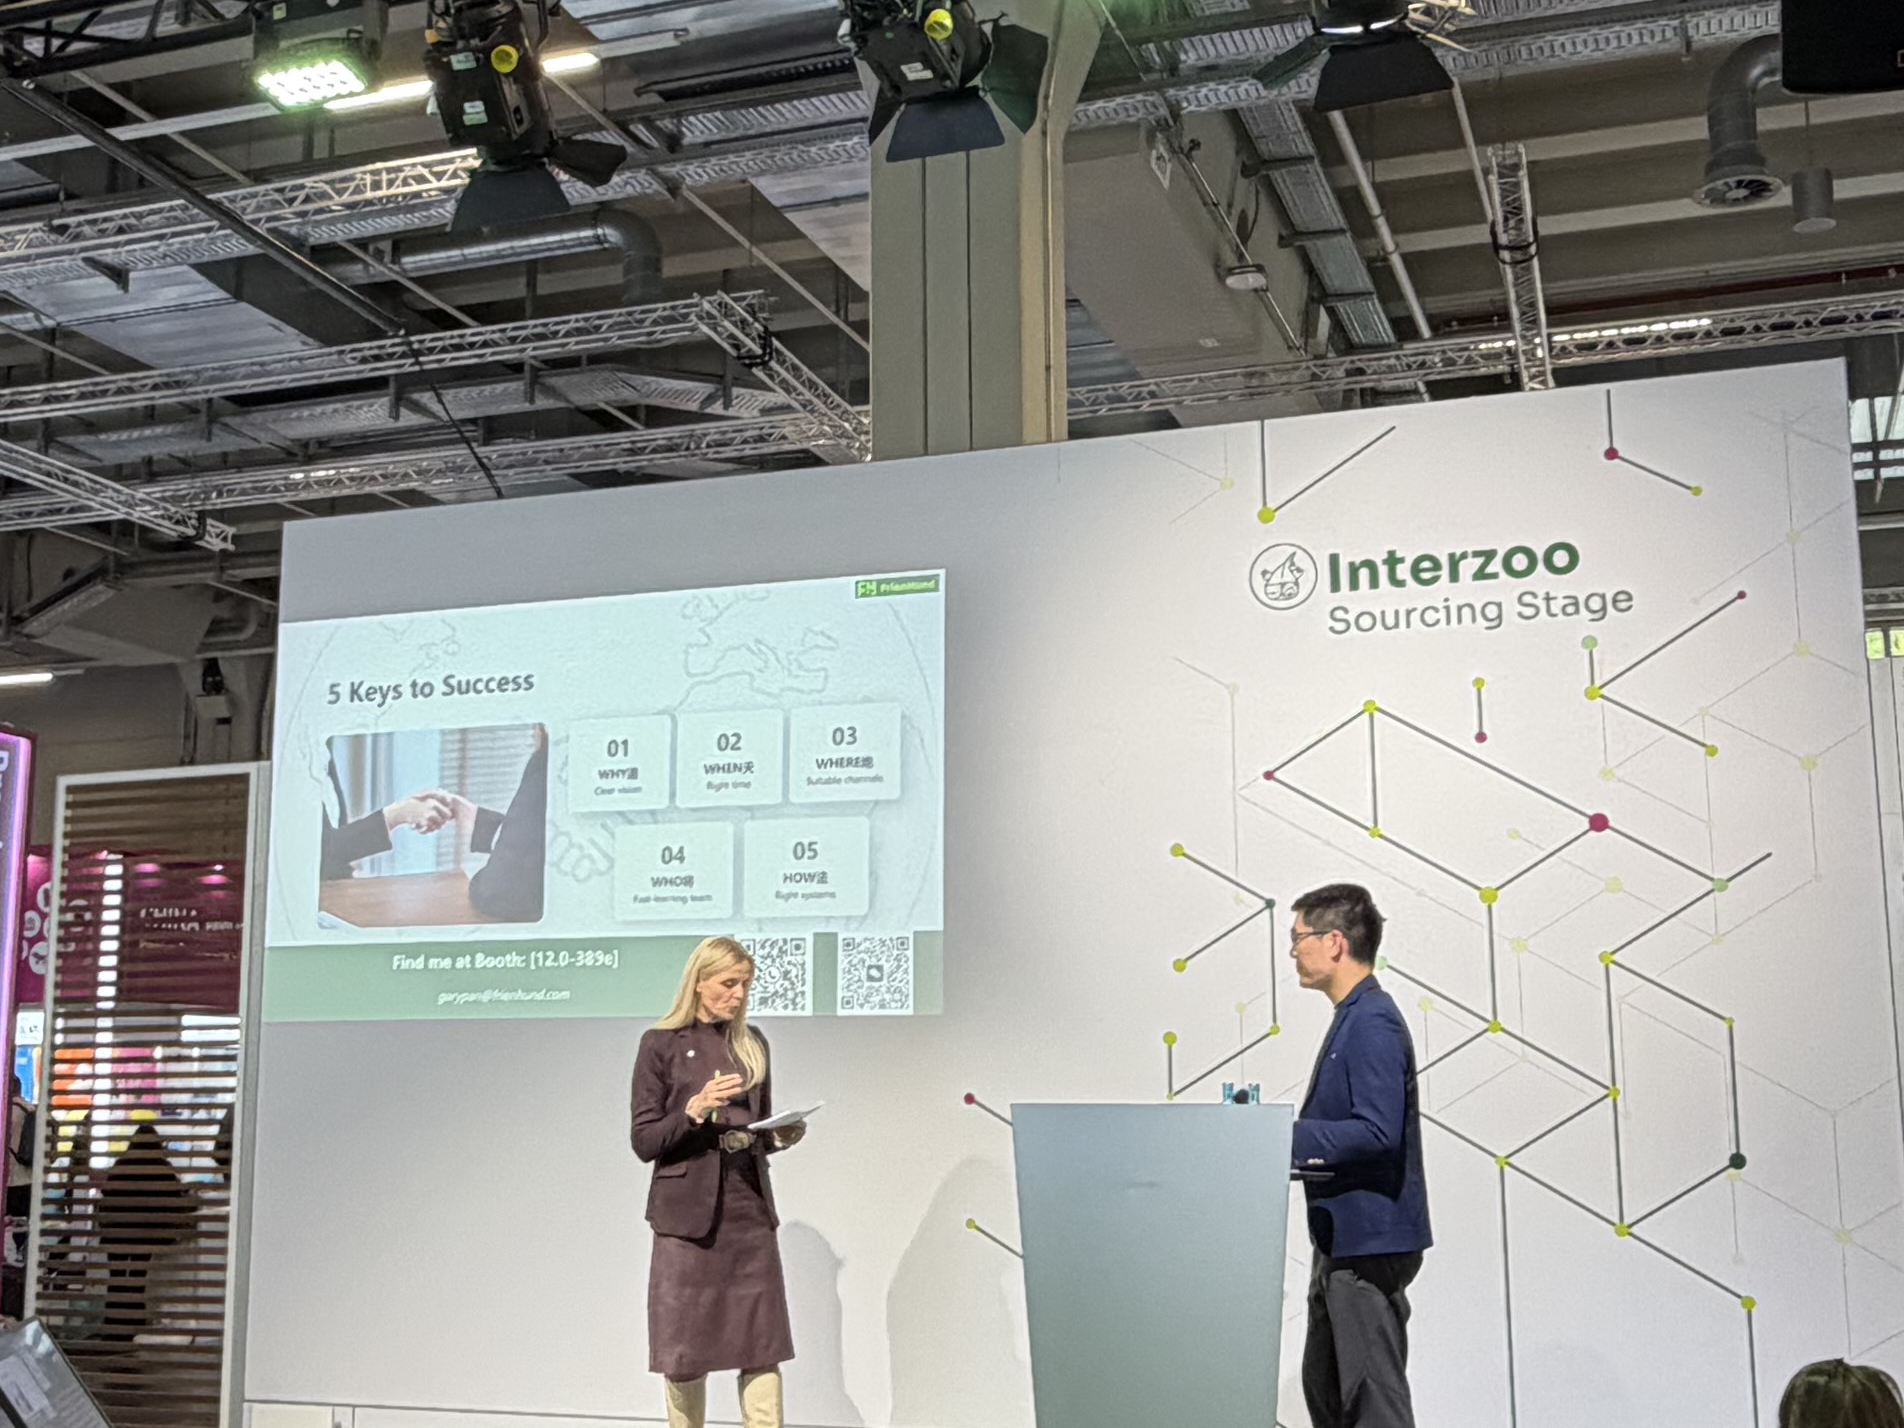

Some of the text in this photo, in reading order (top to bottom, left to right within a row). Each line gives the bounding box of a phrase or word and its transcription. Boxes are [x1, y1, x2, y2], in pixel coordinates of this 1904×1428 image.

[1328, 541, 1580, 594] Interzoo
[1327, 589, 1635, 635] Sourcing Stage
[327, 674, 535, 708] 5 Keys to Success
[716, 732, 743, 752] 02
[831, 726, 858, 746] 03
[607, 739, 630, 758] 01
[660, 846, 686, 866] 04
[792, 841, 819, 861] 05
[393, 954, 424, 970] Find
[428, 957, 452, 969] me
[455, 954, 471, 969] at
[475, 951, 526, 968] Booth:
